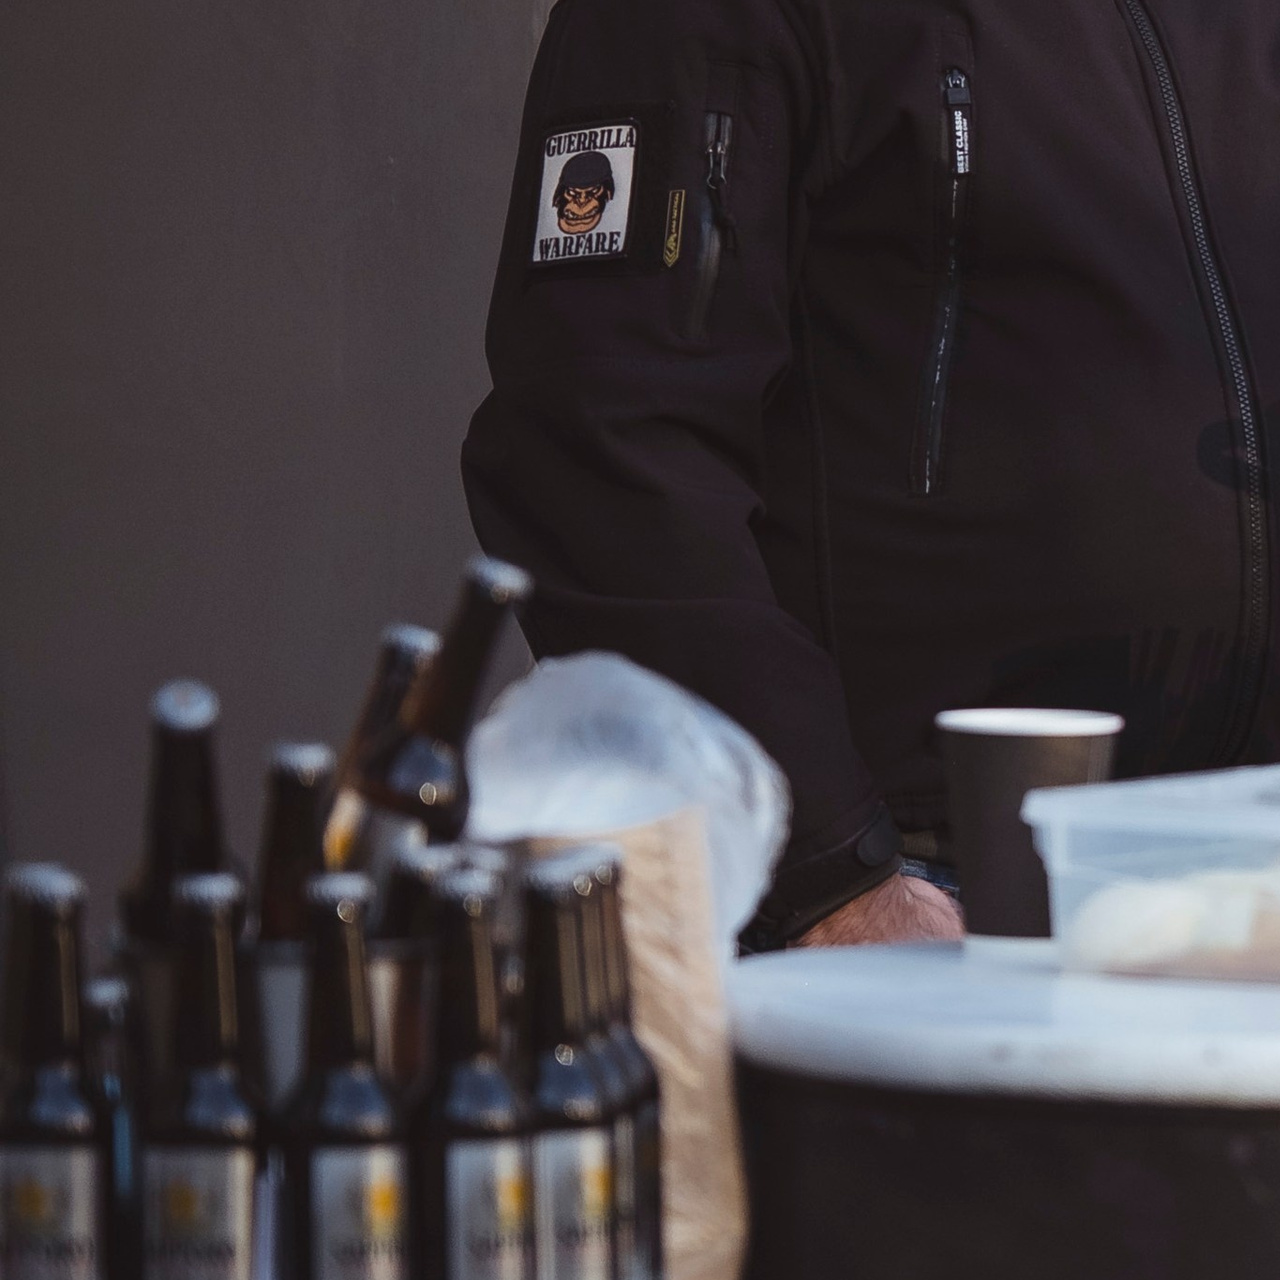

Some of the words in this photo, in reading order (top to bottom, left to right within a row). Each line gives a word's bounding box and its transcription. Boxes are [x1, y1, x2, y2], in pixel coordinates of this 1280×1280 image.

[546, 128, 635, 157] GUERRILLA
[954, 110, 963, 148] CLASSIC
[956, 150, 965, 173] BEST
[539, 231, 621, 260] WARFARE
